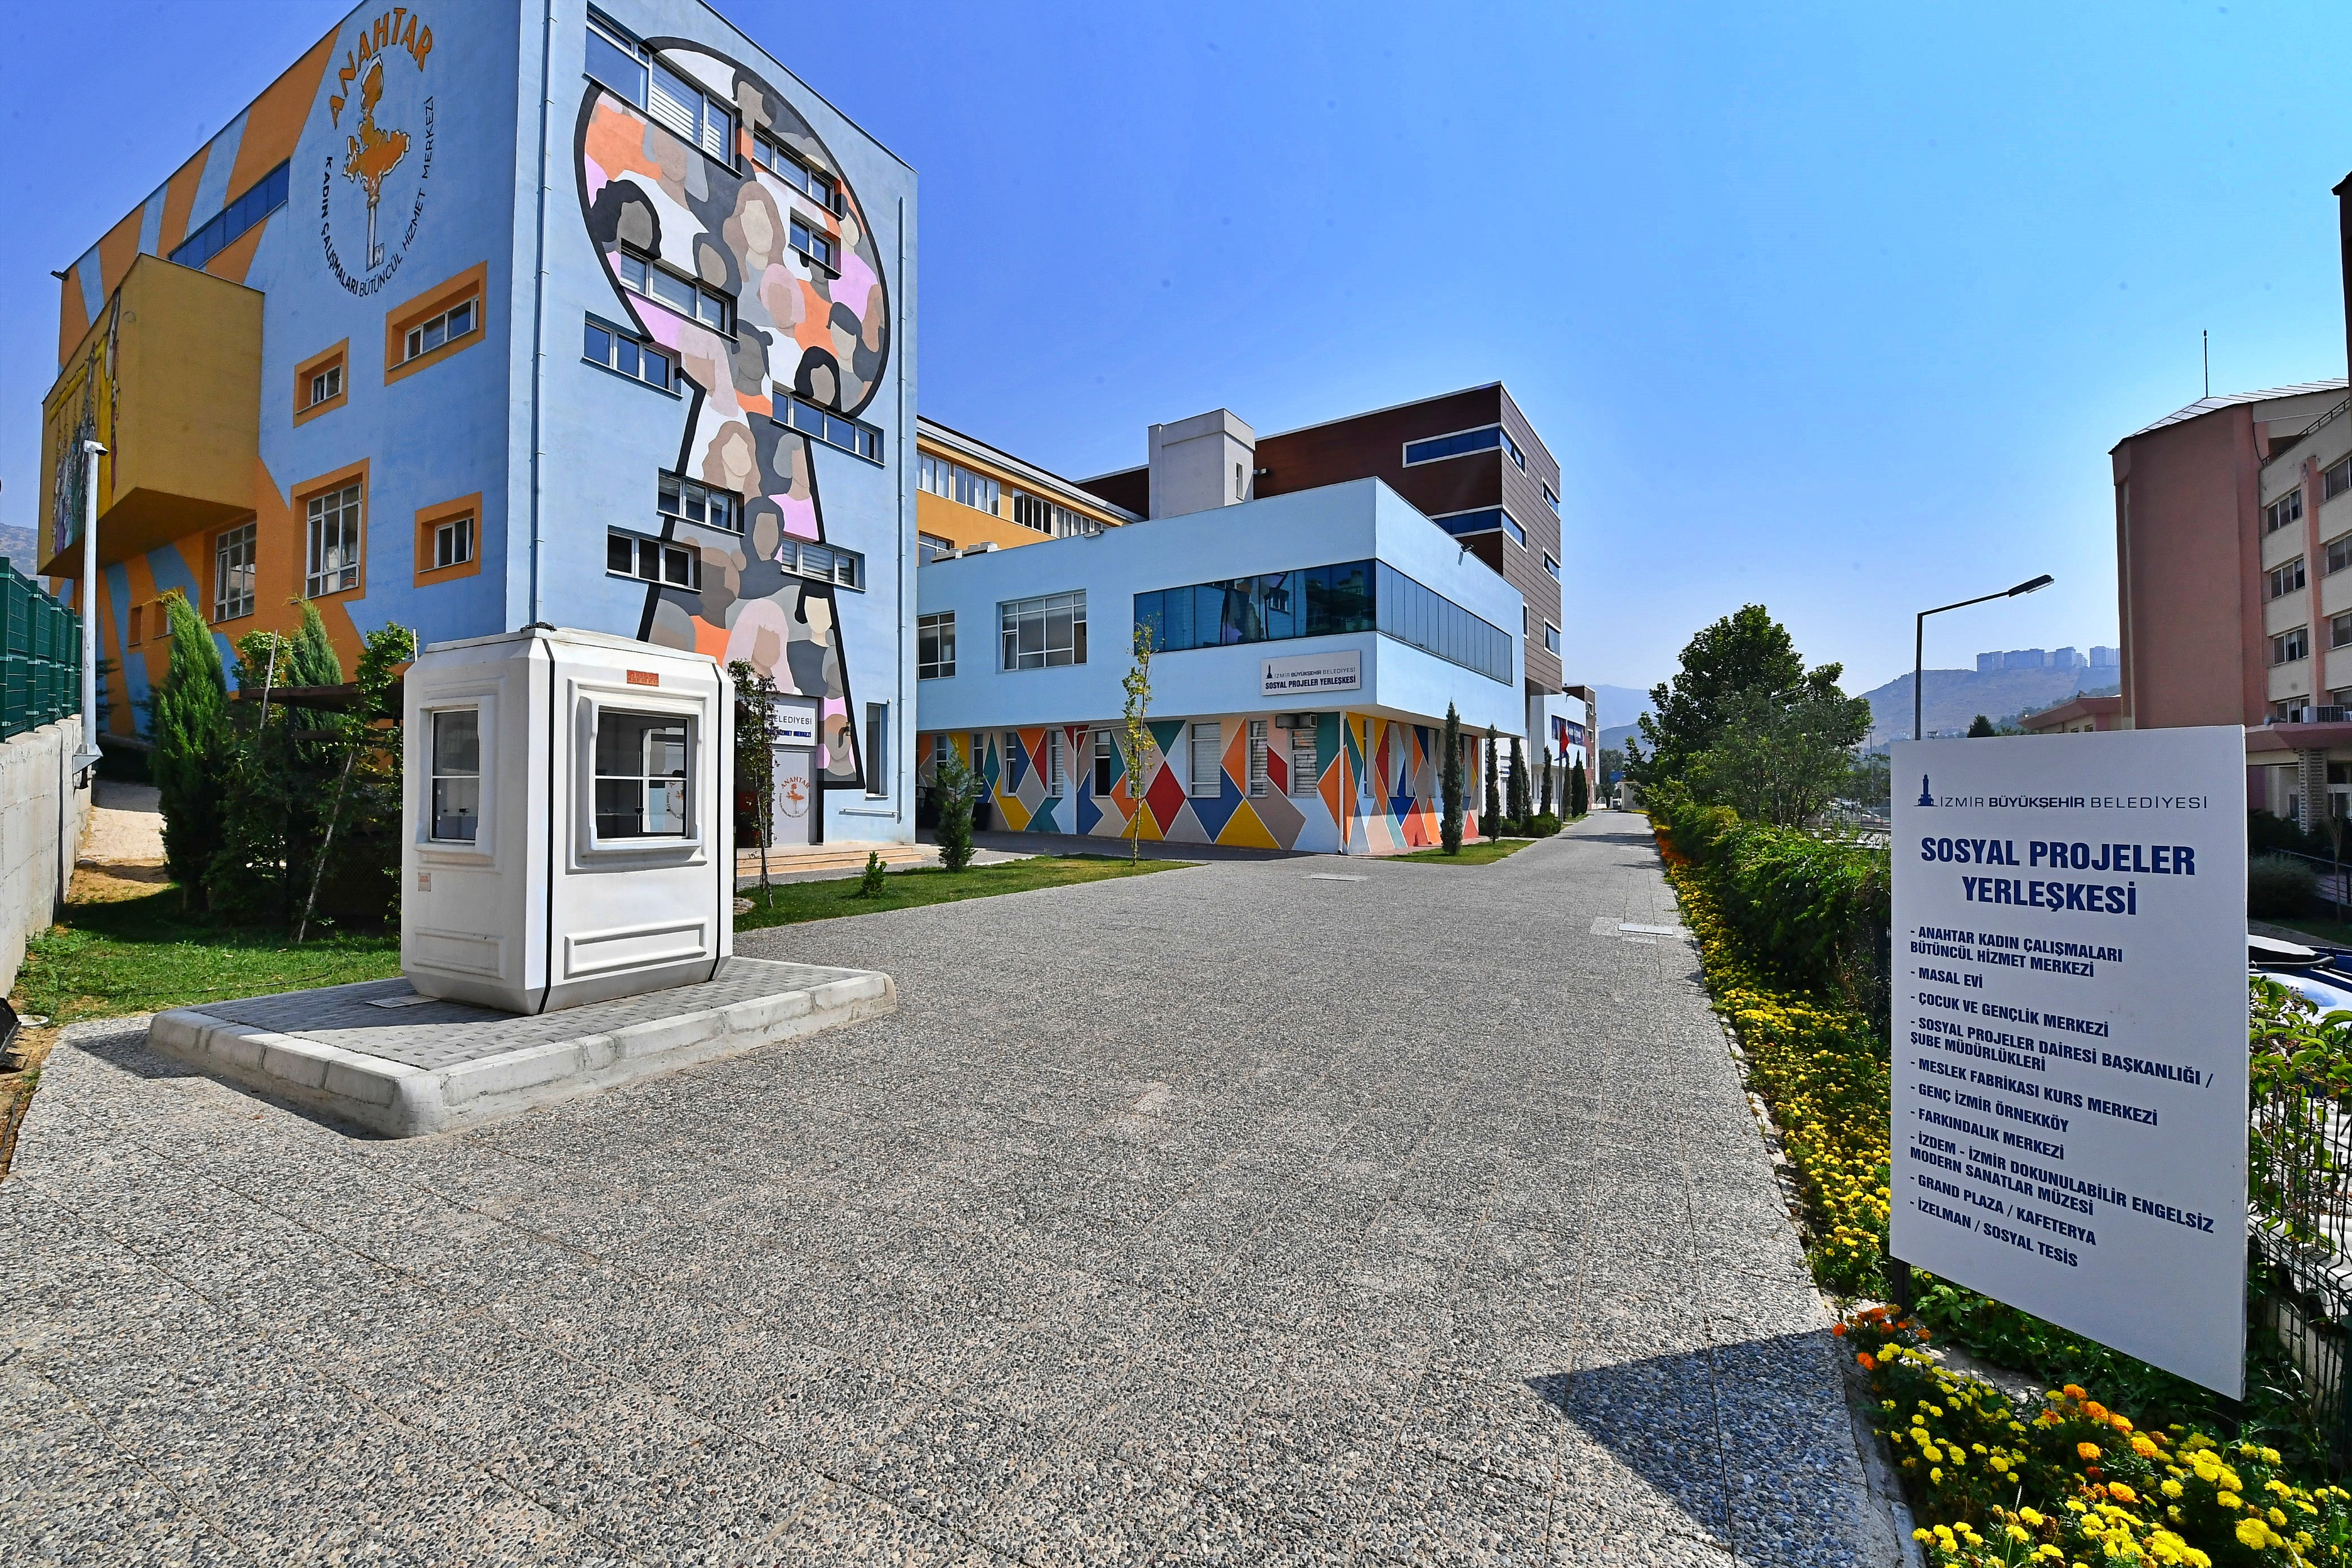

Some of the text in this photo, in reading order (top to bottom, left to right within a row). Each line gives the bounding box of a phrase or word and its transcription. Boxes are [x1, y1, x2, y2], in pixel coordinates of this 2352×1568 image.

[329, 7, 433, 130] ANAHTAR
[321, 96, 433, 297] KADIN ÇALIŞMALARI BÜTÜNCÜL HİZMET MERKEZİ
[1266, 674, 1356, 689] SOSYAL PROJELER YERLEŞKESİ
[781, 777, 810, 789] ANAHTAR
[1940, 795, 2207, 809] İZMİR BÜYÜKŞEHİR BELEDİYESİ
[1921, 837, 2195, 876] SOSYAL PROJELER
[1961, 876, 2136, 915] YERLEŞKESİ
[1910, 939, 2094, 978] BÜTÜNCÜL HİZMET MERKEZİ
[1918, 926, 1975, 945] ANAHTAR
[1979, 933, 2019, 950] KADIN
[2023, 938, 2123, 963] ÇALIŞMALARI
[1918, 966, 1961, 985] MASAL
[1964, 973, 1983, 989] EVİ
[1918, 992, 1960, 1011] ÇOCUK
[1962, 999, 1978, 1014] VE
[1981, 1003, 2039, 1026] GENÇLİK
[2043, 1013, 2109, 1038] MERKEZİ
[1910, 1031, 2046, 1072] ŞUBE MÜDÜRLÜKLERİ
[1918, 1017, 1964, 1037] SOSYAL
[1967, 1026, 2034, 1052] PROJELER
[2039, 1040, 2097, 1064] DAİRESİ
[2102, 1052, 2200, 1085] BAŞKANLIĞI
[1918, 1058, 1967, 1081] MESLEK
[1970, 1070, 2039, 1098] FABRİKASI
[2044, 1086, 2083, 1108] KURS
[2087, 1097, 2158, 1126] MERKEZİ
[1918, 1083, 1951, 1103] GENÇ
[1954, 1089, 1992, 1113] İZMİR
[1995, 1100, 2069, 1133] ÖRNEKKÖY
[1918, 1107, 1999, 1142] FARKINDALIK
[2003, 1131, 2064, 1160] MERKEZİ
[1910, 1146, 2093, 1216] MODERN SANATLAR MÜZESİ
[1918, 1130, 1956, 1155] İZDEM
[1968, 1145, 2006, 1171] İZMİR
[2010, 1160, 2127, 1208] DOKUNULABİLİR
[2132, 1196, 2214, 1234] ENGELSİZ
[1918, 1174, 1959, 1199] GRAND
[1963, 1189, 2004, 1214] PLAZA
[2016, 1206, 2096, 1246] KAFETERYA
[1918, 1196, 1971, 1229] İZELMAN
[1983, 1223, 2034, 1252] SOSYAL
[2037, 1241, 2078, 1267] TESİS
